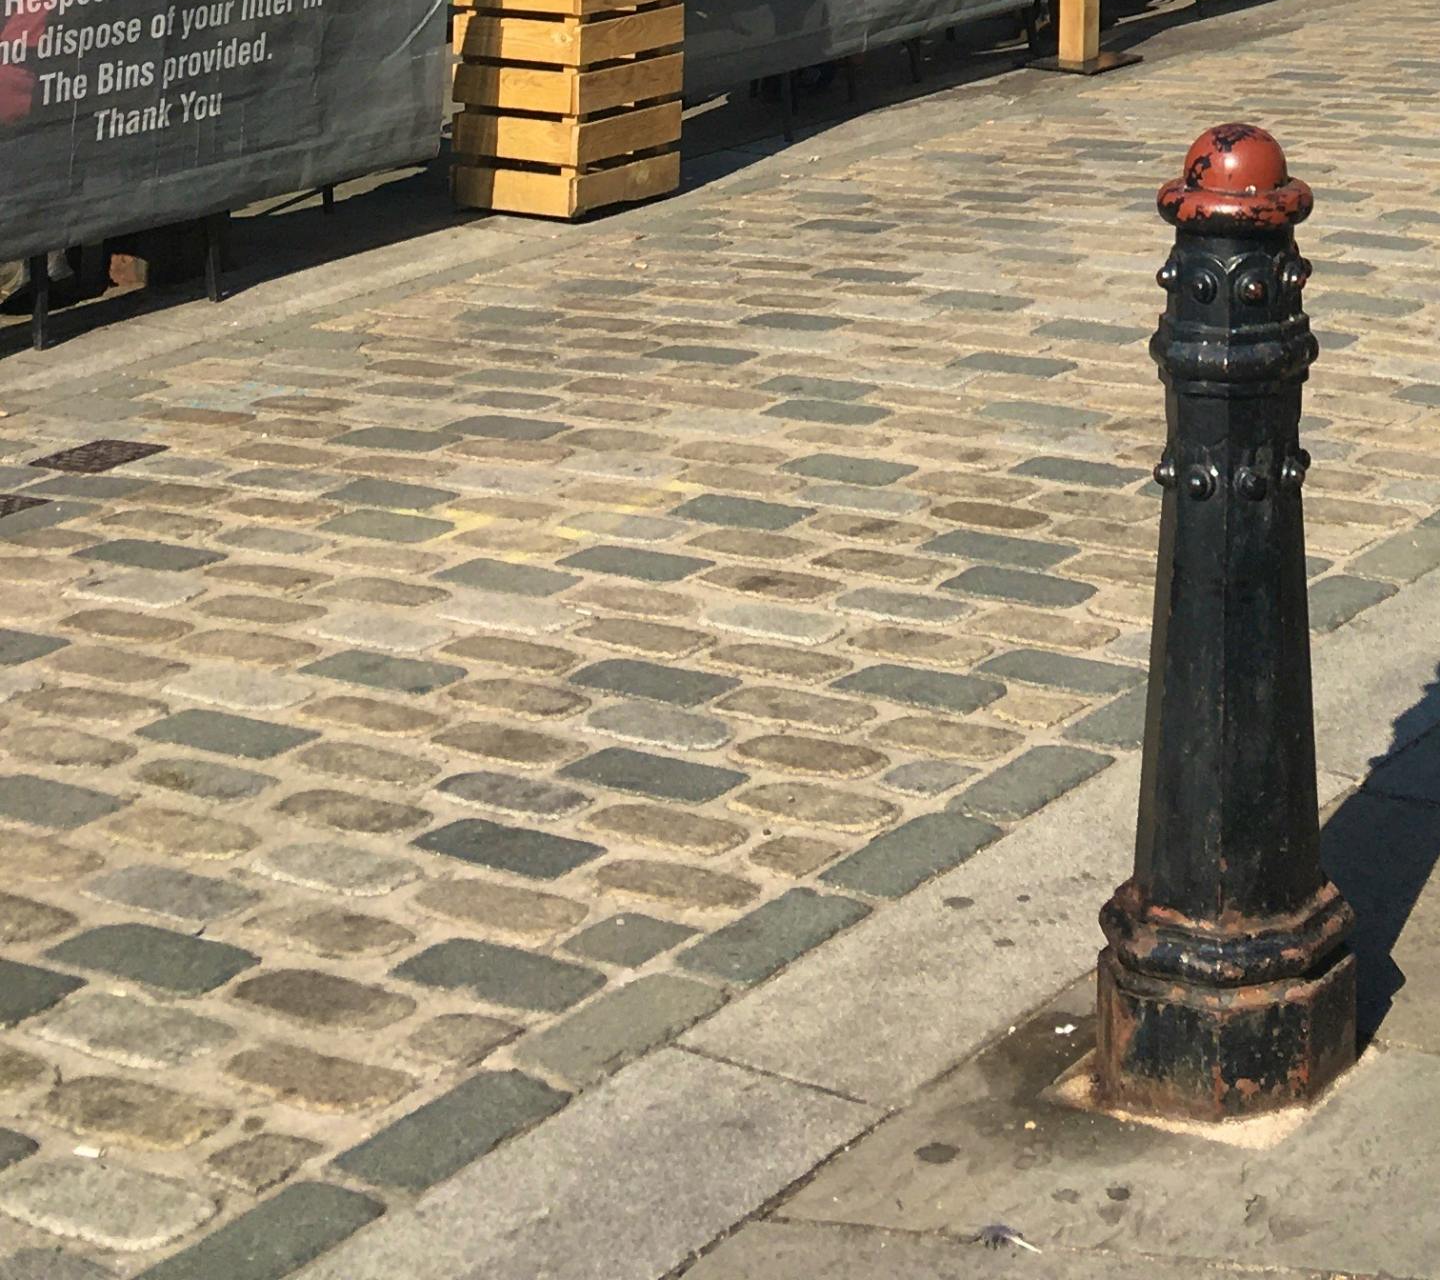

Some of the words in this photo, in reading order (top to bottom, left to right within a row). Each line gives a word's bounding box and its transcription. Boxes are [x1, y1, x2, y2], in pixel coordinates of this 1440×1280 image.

[37, 17, 141, 60] dispose
[151, 5, 176, 40] of
[182, 0, 235, 40] your
[39, 71, 88, 106] The
[97, 59, 155, 96] Bins
[162, 31, 273, 90] provided.
[93, 97, 173, 141] Thank
[180, 90, 223, 124] You
